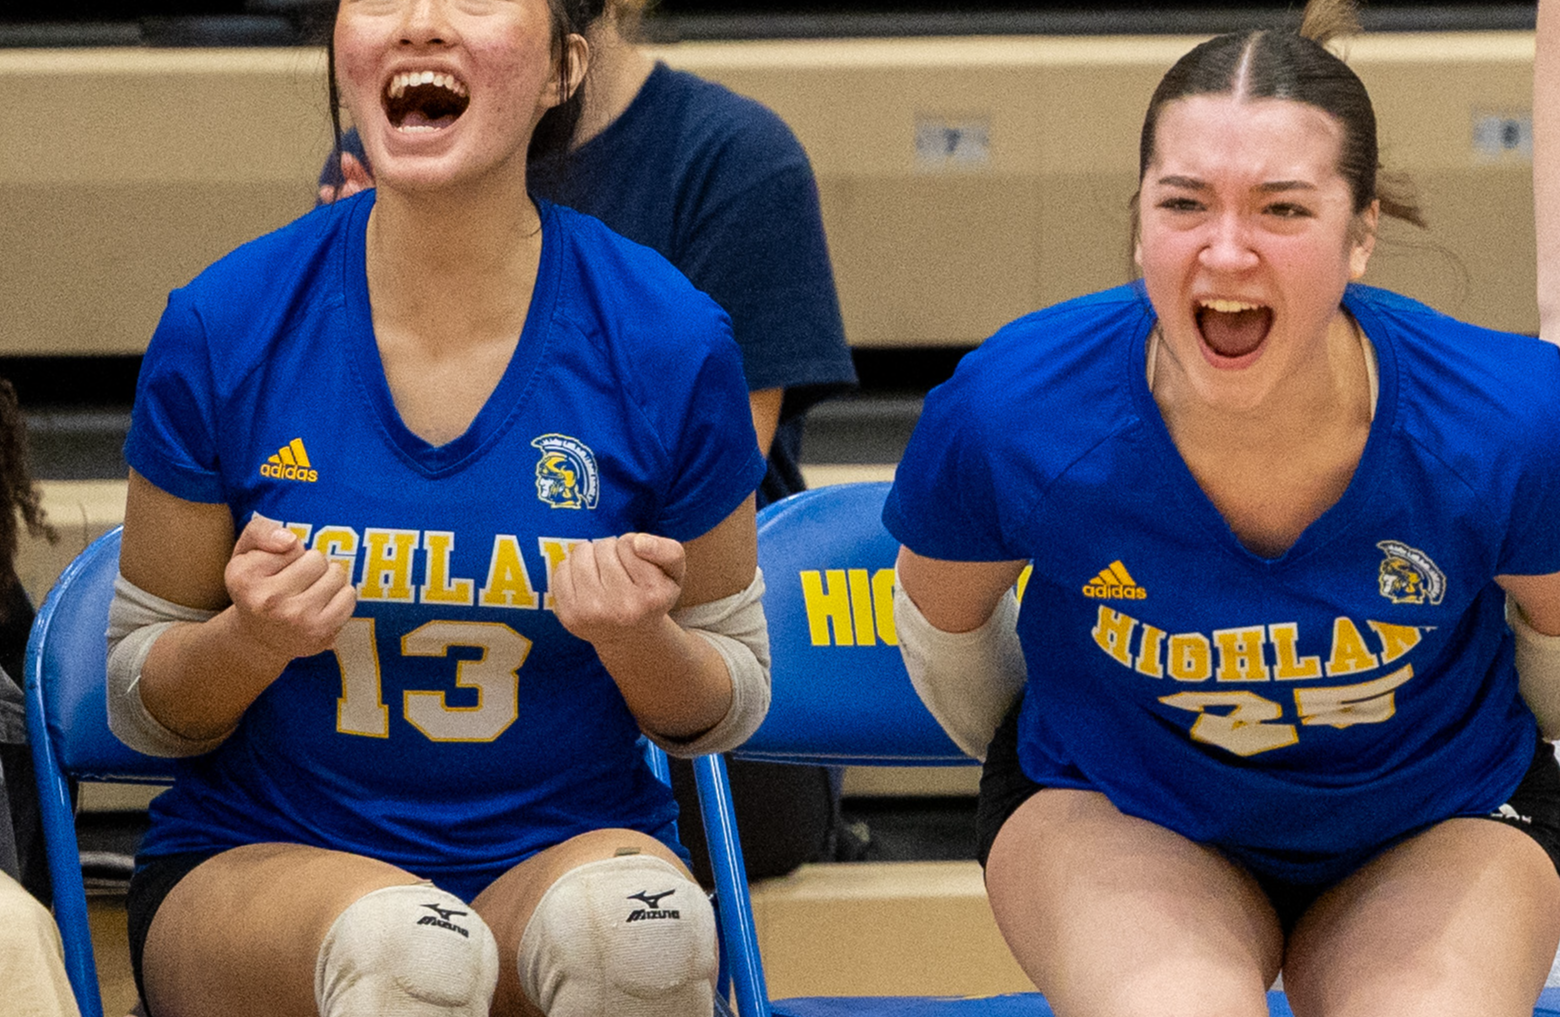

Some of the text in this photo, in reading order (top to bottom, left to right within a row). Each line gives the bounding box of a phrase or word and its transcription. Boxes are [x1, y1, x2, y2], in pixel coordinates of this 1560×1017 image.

[259, 461, 319, 482] adidas
[253, 512, 616, 610] GHLA
[1082, 584, 1148, 600] adidas
[331, 616, 533, 743] 13
[1091, 604, 1432, 682] HIGHLAN
[1157, 663, 1415, 758] 25
